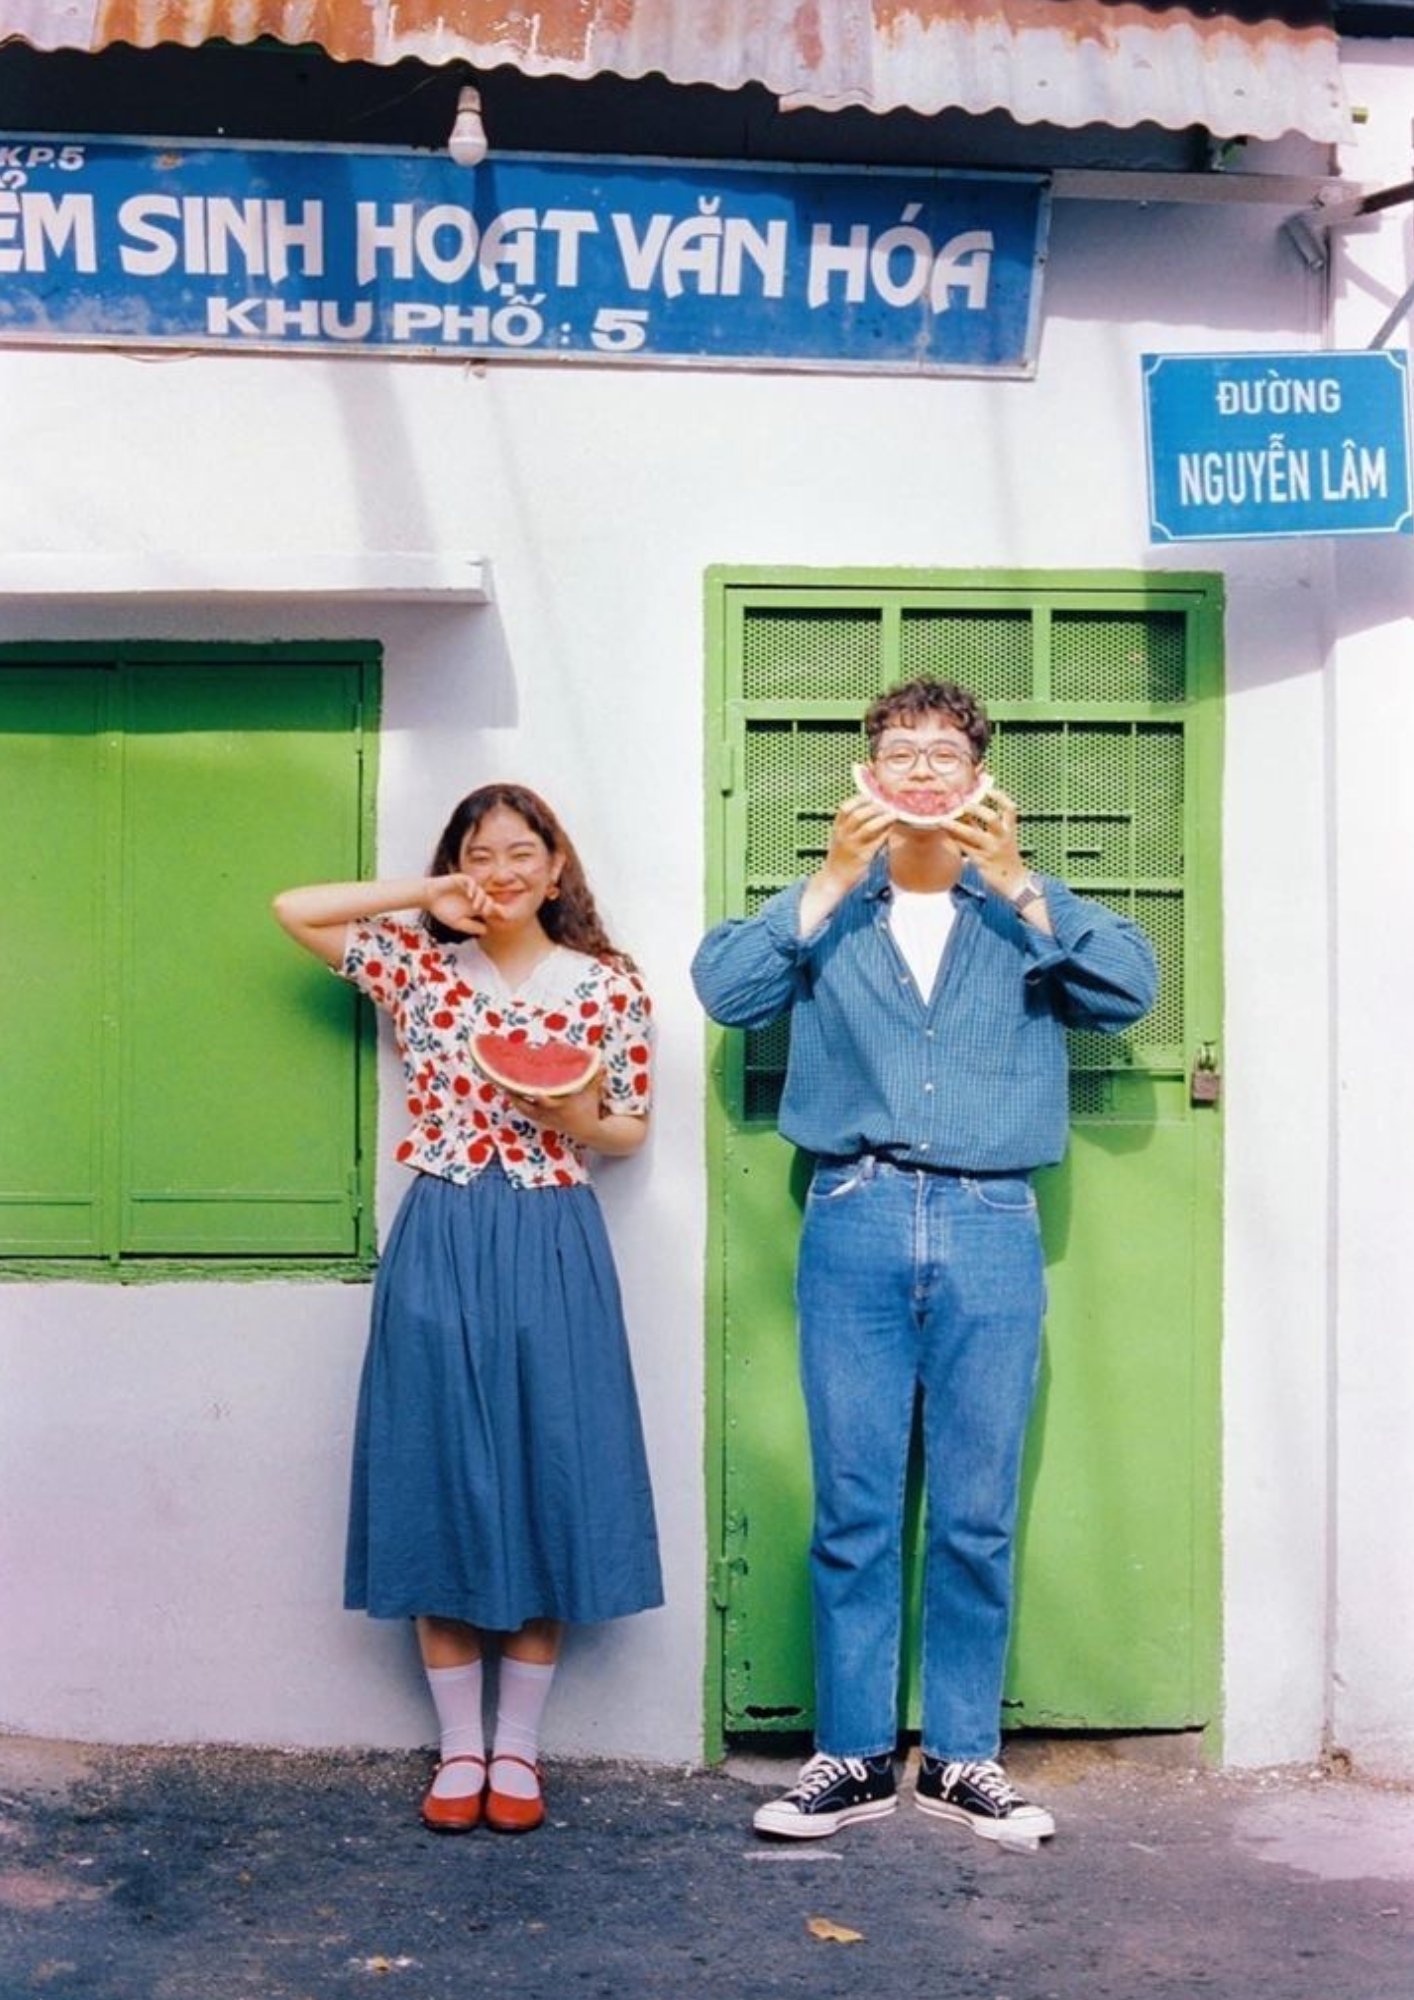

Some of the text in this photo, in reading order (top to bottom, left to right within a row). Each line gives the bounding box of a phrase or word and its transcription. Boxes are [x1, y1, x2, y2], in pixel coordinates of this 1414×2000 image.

[118, 194, 324, 284] SINH
[357, 202, 599, 296] HOẠT
[610, 196, 787, 298] VĂN
[807, 203, 994, 314] HÓA
[207, 298, 373, 338] KHU
[392, 293, 547, 346] PHỐ
[591, 308, 649, 350] 5
[1215, 369, 1342, 415] ĐƯỜNG
[1178, 433, 1388, 506] NGUYỄN LÂM
